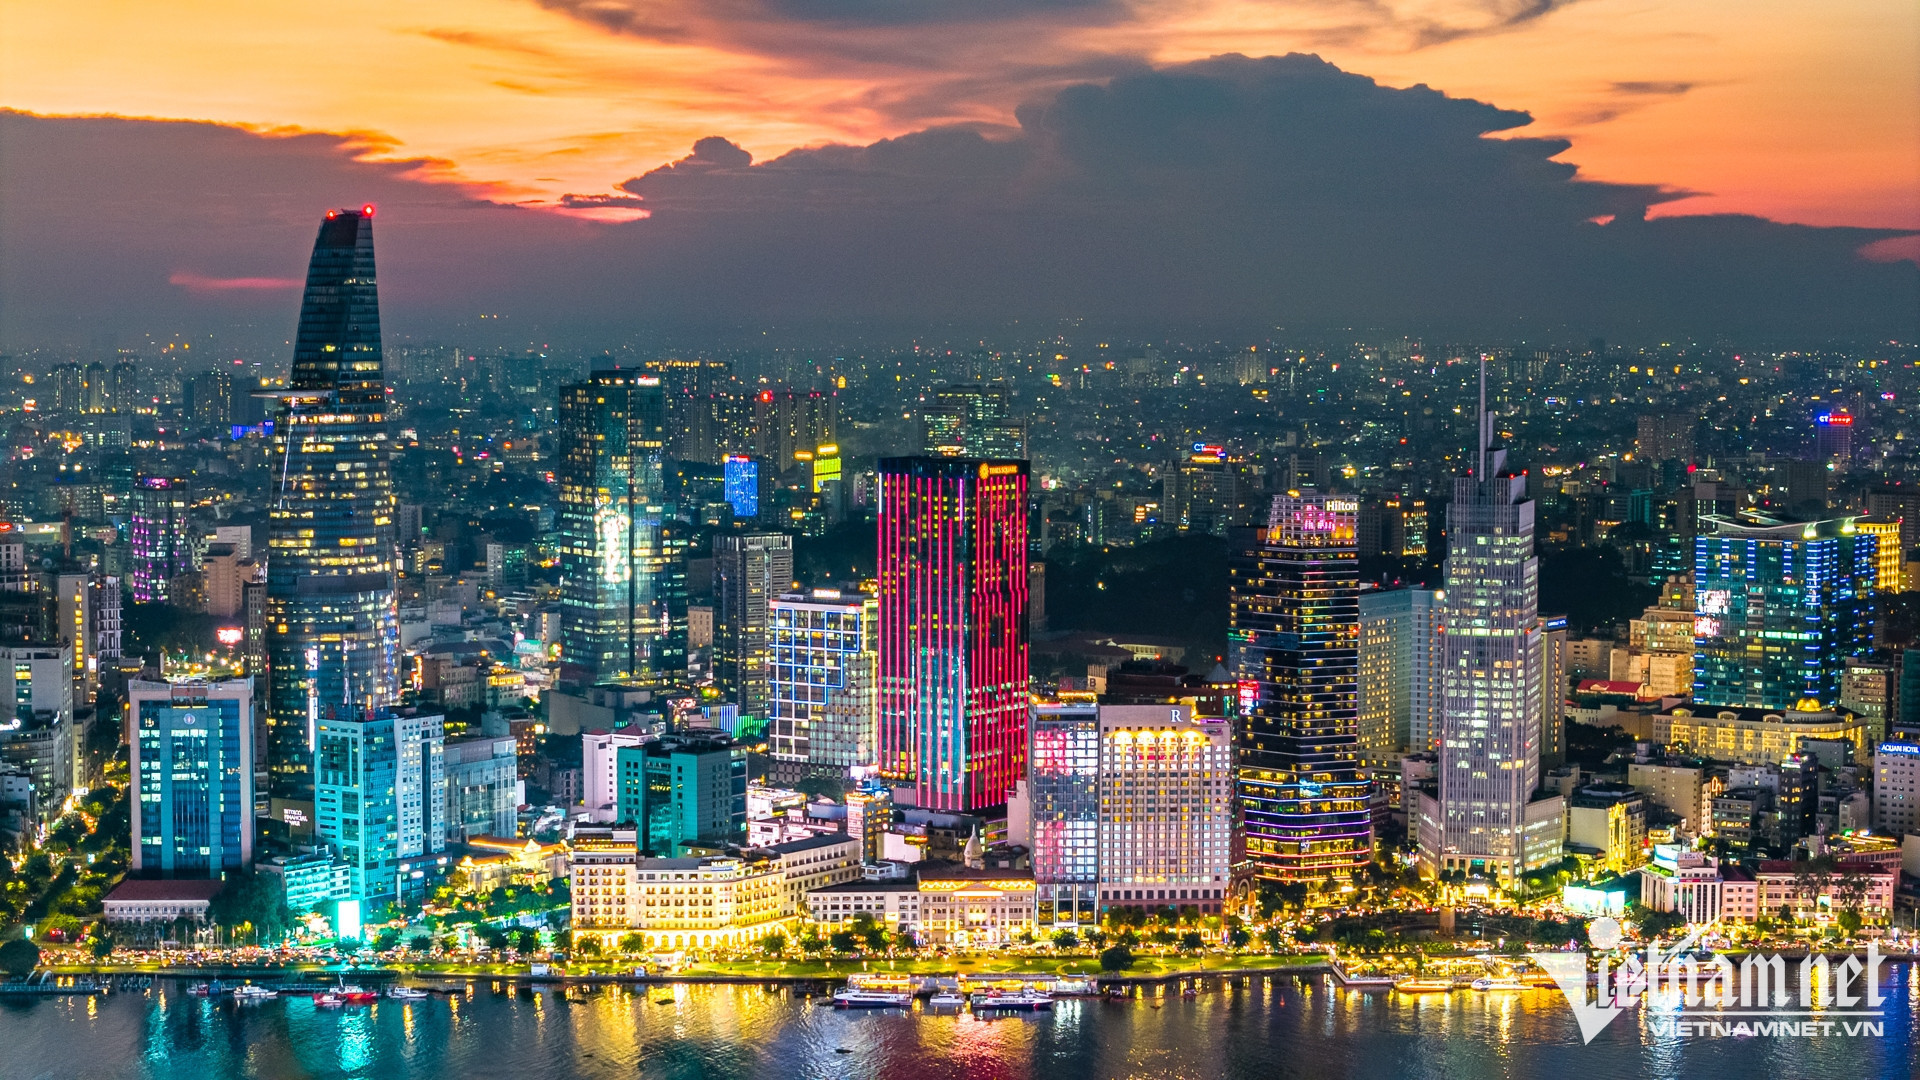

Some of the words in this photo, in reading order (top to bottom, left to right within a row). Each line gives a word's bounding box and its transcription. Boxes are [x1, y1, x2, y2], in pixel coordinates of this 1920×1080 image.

[1193, 443, 1205, 452] CT
[1001, 465, 1018, 475] SQUARE
[1326, 500, 1359, 511] Hilton
[1170, 709, 1183, 722] R
[1902, 745, 1919, 753] HOTEL
